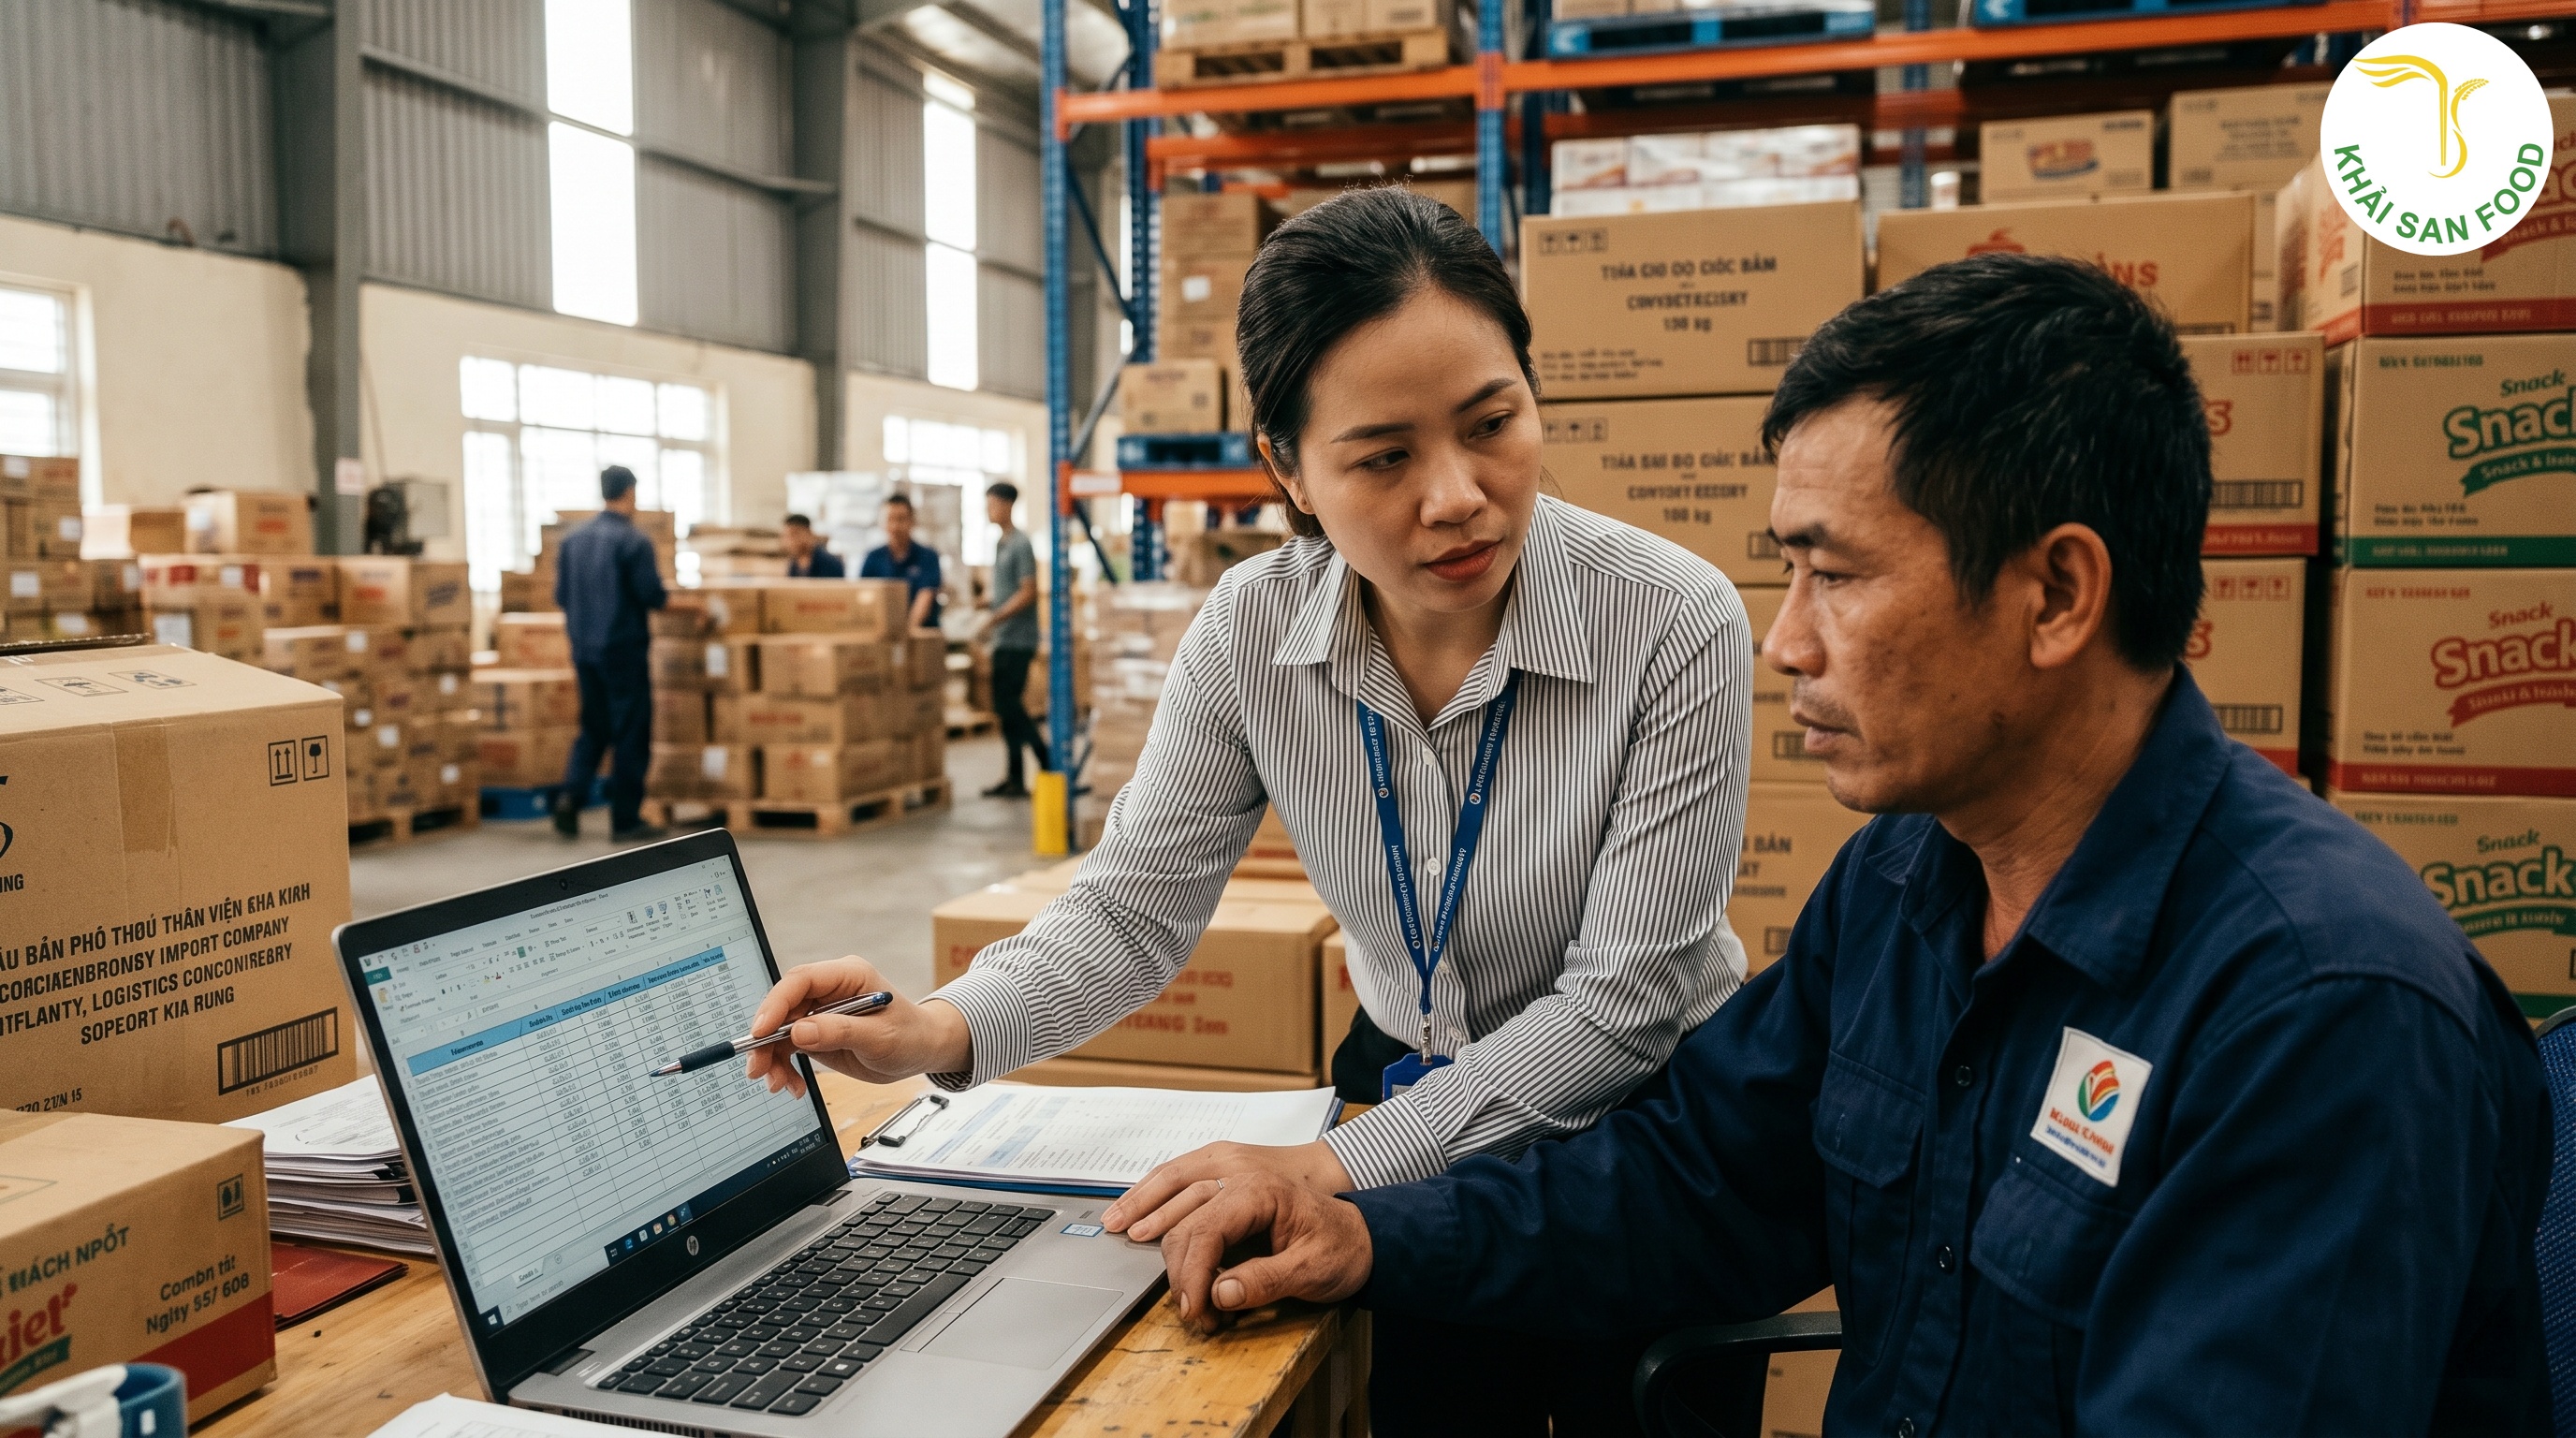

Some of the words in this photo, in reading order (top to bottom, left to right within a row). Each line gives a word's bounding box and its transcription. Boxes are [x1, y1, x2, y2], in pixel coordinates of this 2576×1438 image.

[2501, 369, 2566, 397] Snack
[2489, 601, 2554, 629] Snack
[2477, 829, 2540, 854] Snack
[70, 926, 106, 956] PHÓ
[162, 907, 204, 934] THÂN
[160, 934, 219, 965] IMPORT
[223, 916, 289, 948] COMPANY
[93, 973, 178, 1012] LOGISTICS
[80, 1007, 158, 1045] SOPEORT
[164, 999, 189, 1022] KIA
[194, 986, 234, 1013] RUNG
